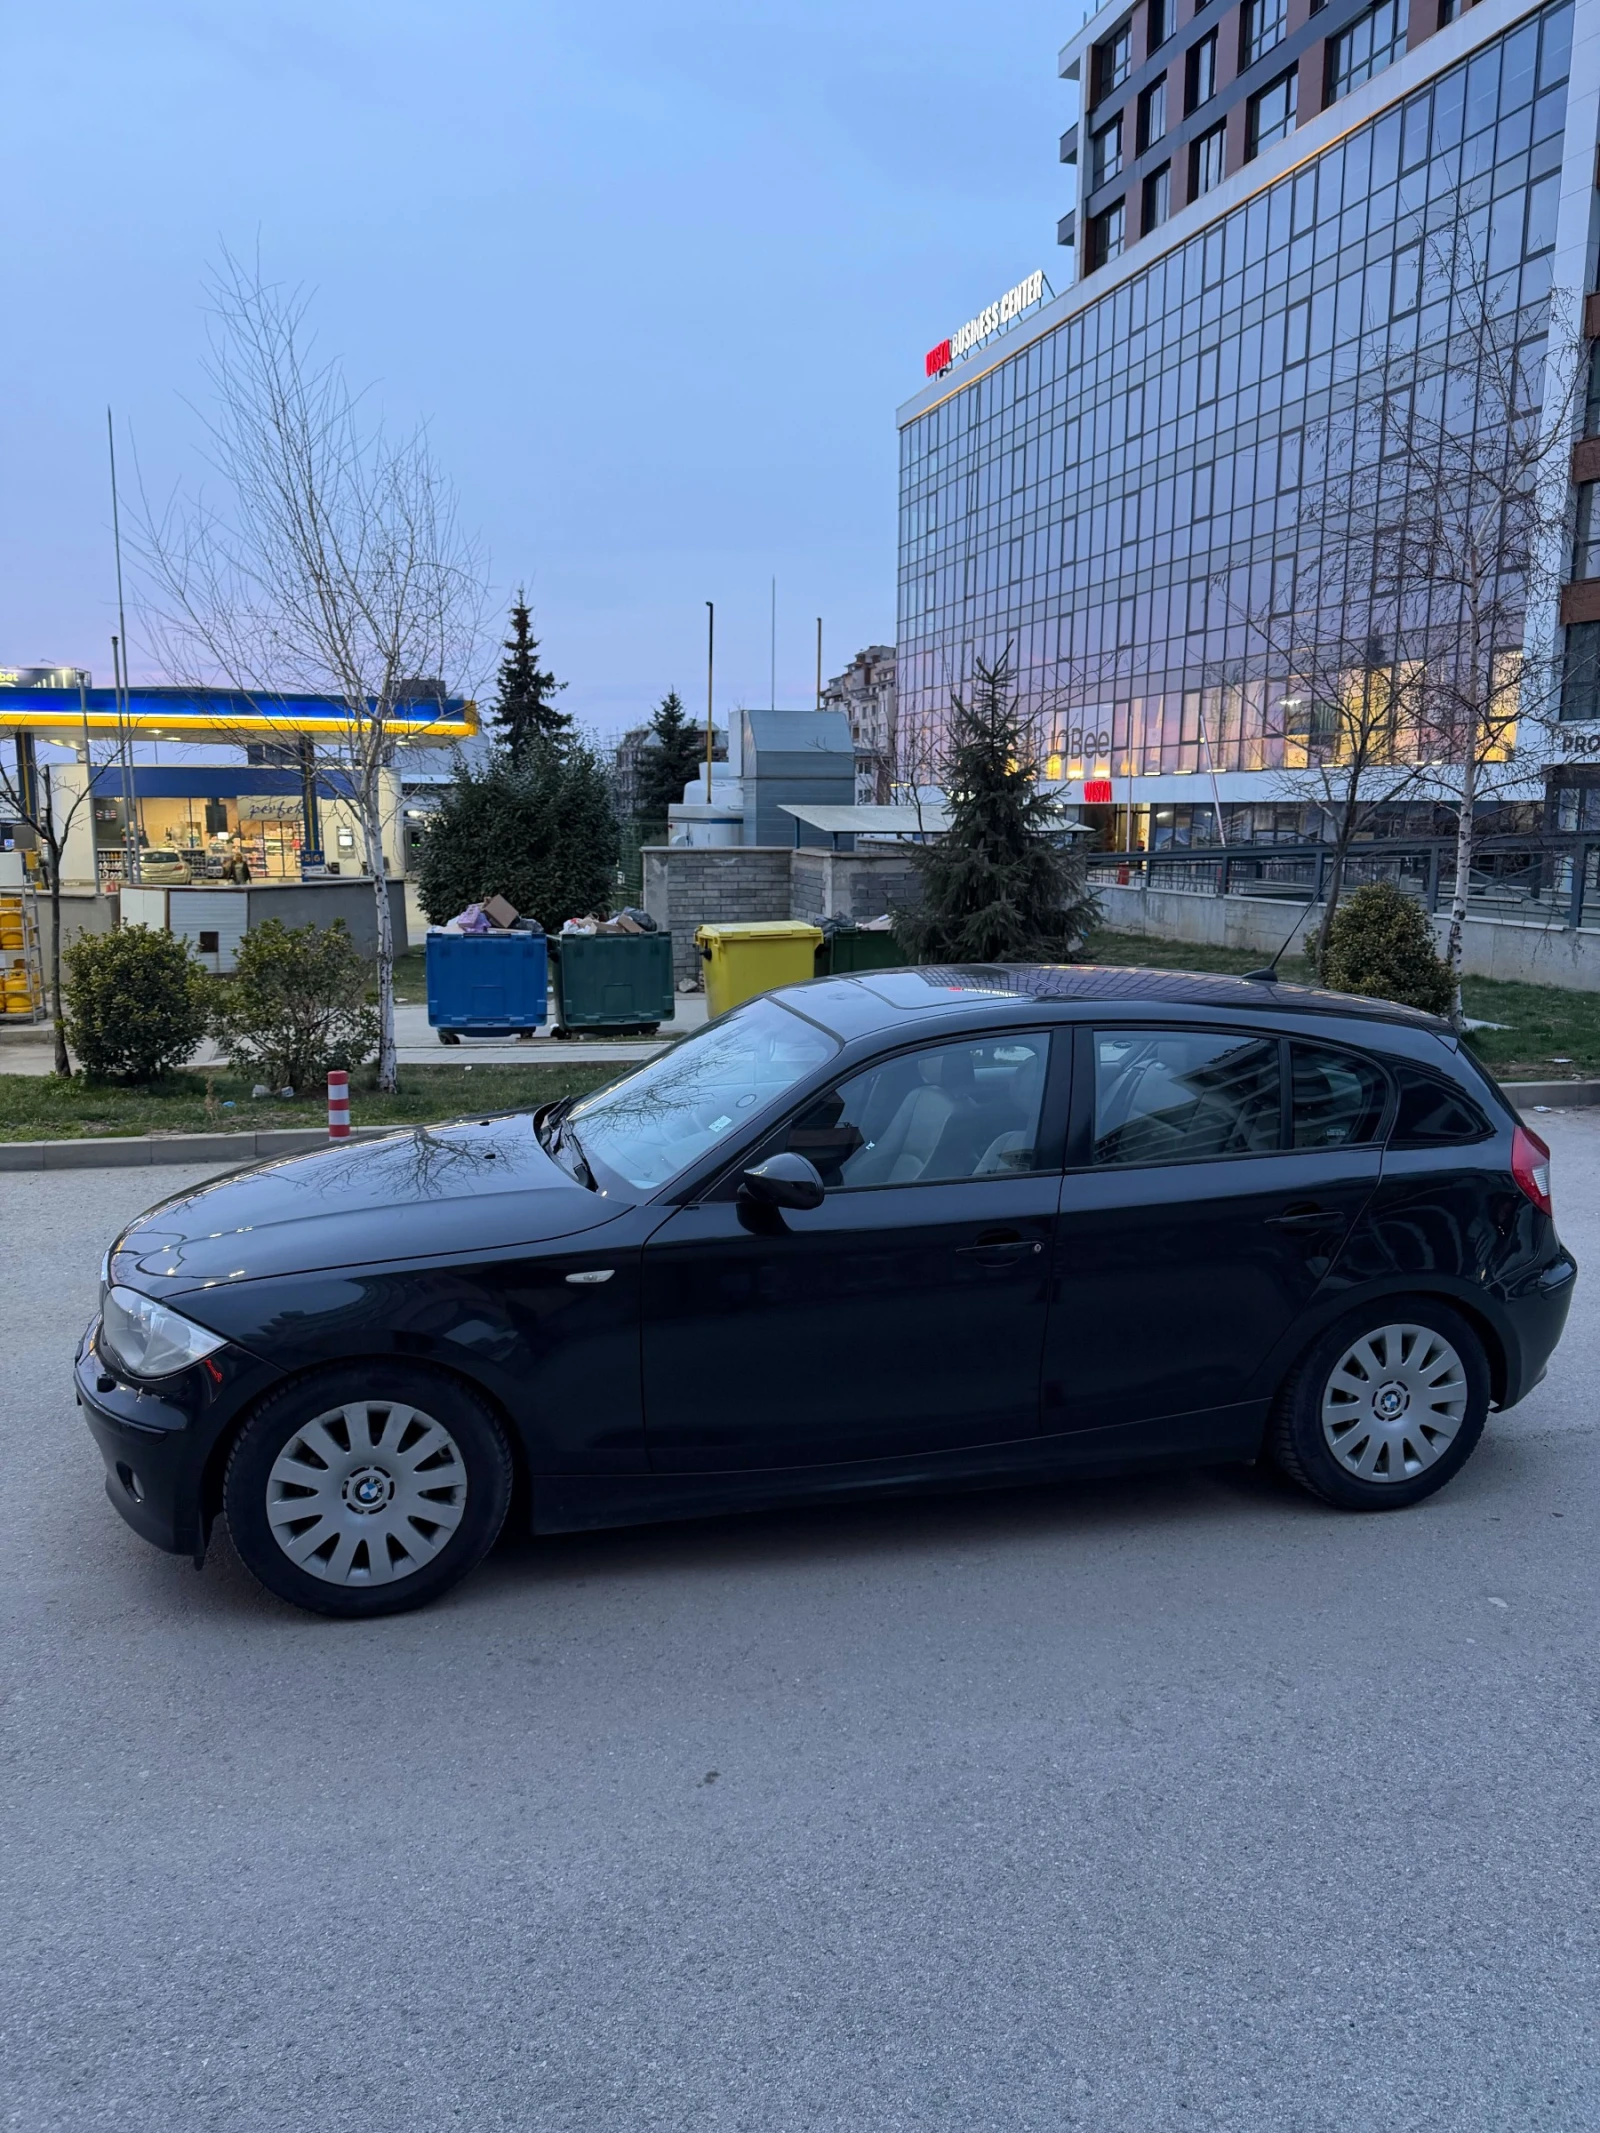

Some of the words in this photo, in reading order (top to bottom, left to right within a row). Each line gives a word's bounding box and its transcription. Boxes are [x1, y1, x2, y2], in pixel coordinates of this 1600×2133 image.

[951, 301, 999, 358] BUSINESS
[1000, 269, 1043, 323] CENTER
[304, 853, 311, 862] 5
[313, 853, 321, 862] 6
